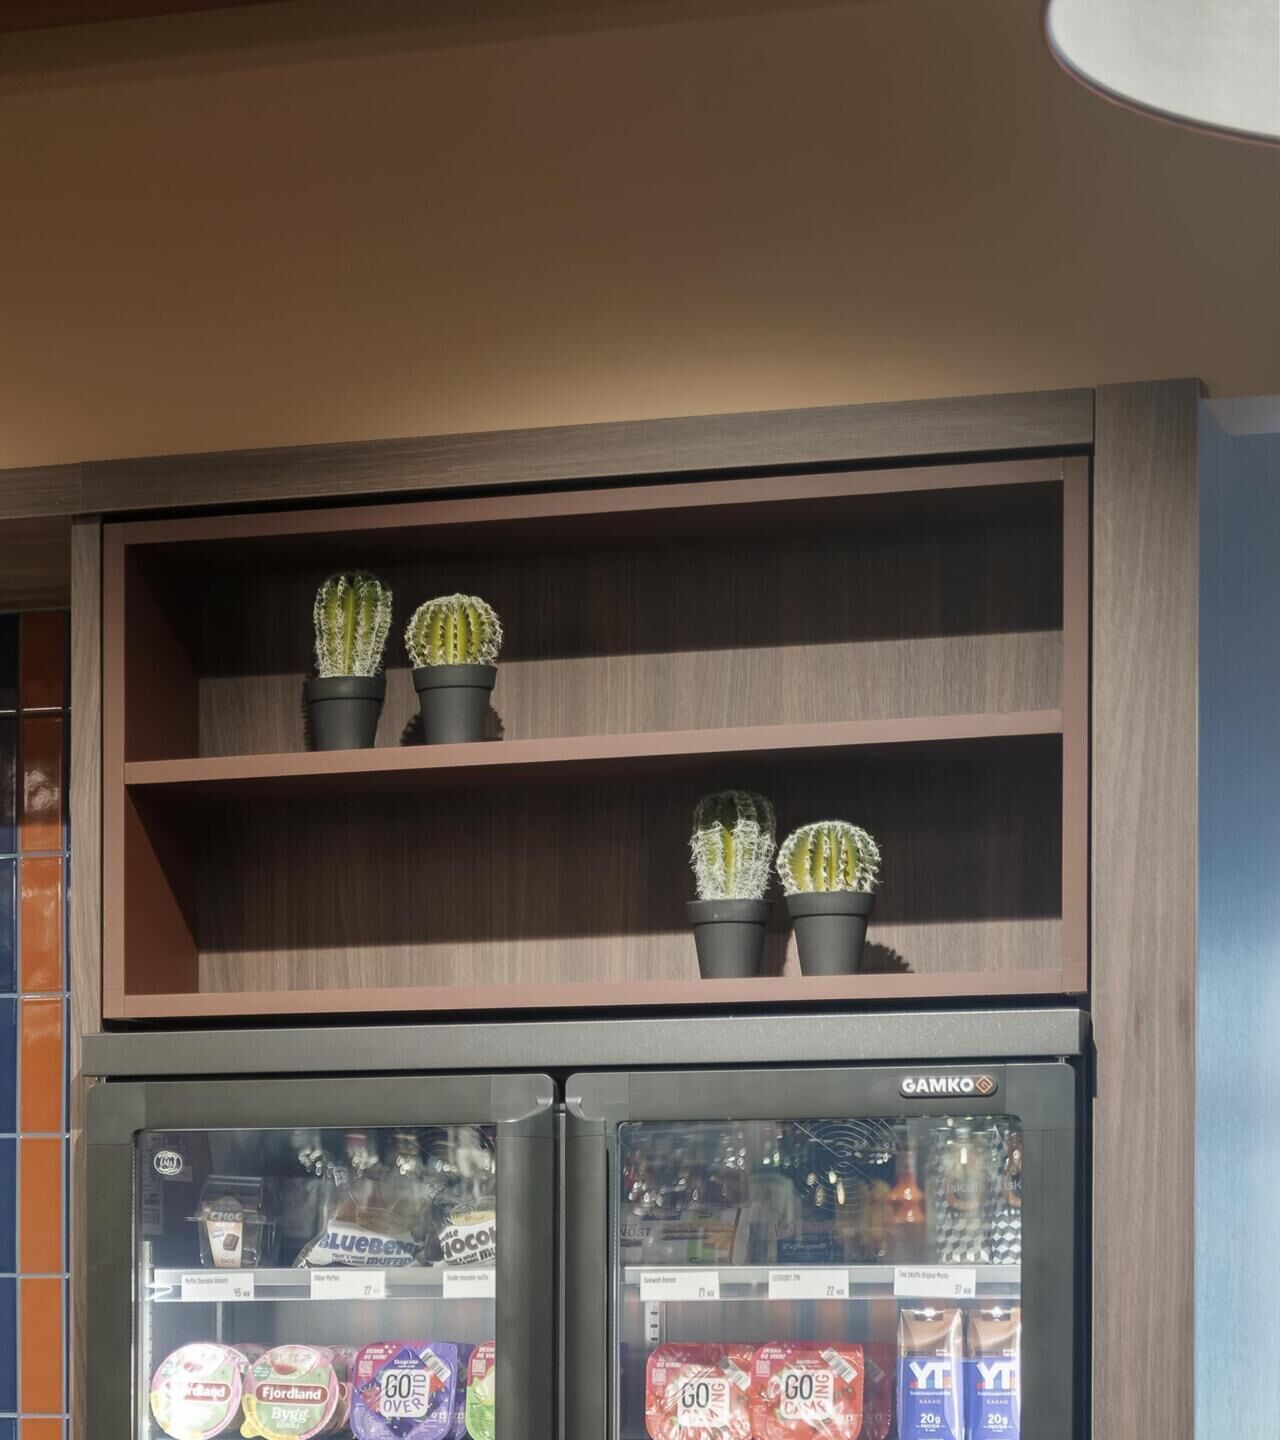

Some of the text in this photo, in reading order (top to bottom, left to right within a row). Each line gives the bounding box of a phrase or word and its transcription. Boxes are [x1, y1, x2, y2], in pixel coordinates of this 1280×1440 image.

[901, 1077, 975, 1093] GAMKO
[826, 1285, 835, 1296] 22
[954, 1284, 962, 1294] 37
[909, 1362, 951, 1390] YT
[263, 1385, 322, 1401] Fjordland
[383, 1374, 427, 1414] OVERTID
[385, 1373, 411, 1399] GO
[785, 1374, 813, 1400] GO
[681, 1382, 709, 1408] GO
[920, 1413, 942, 1424] 20g
[987, 1413, 1008, 1424] 20g
